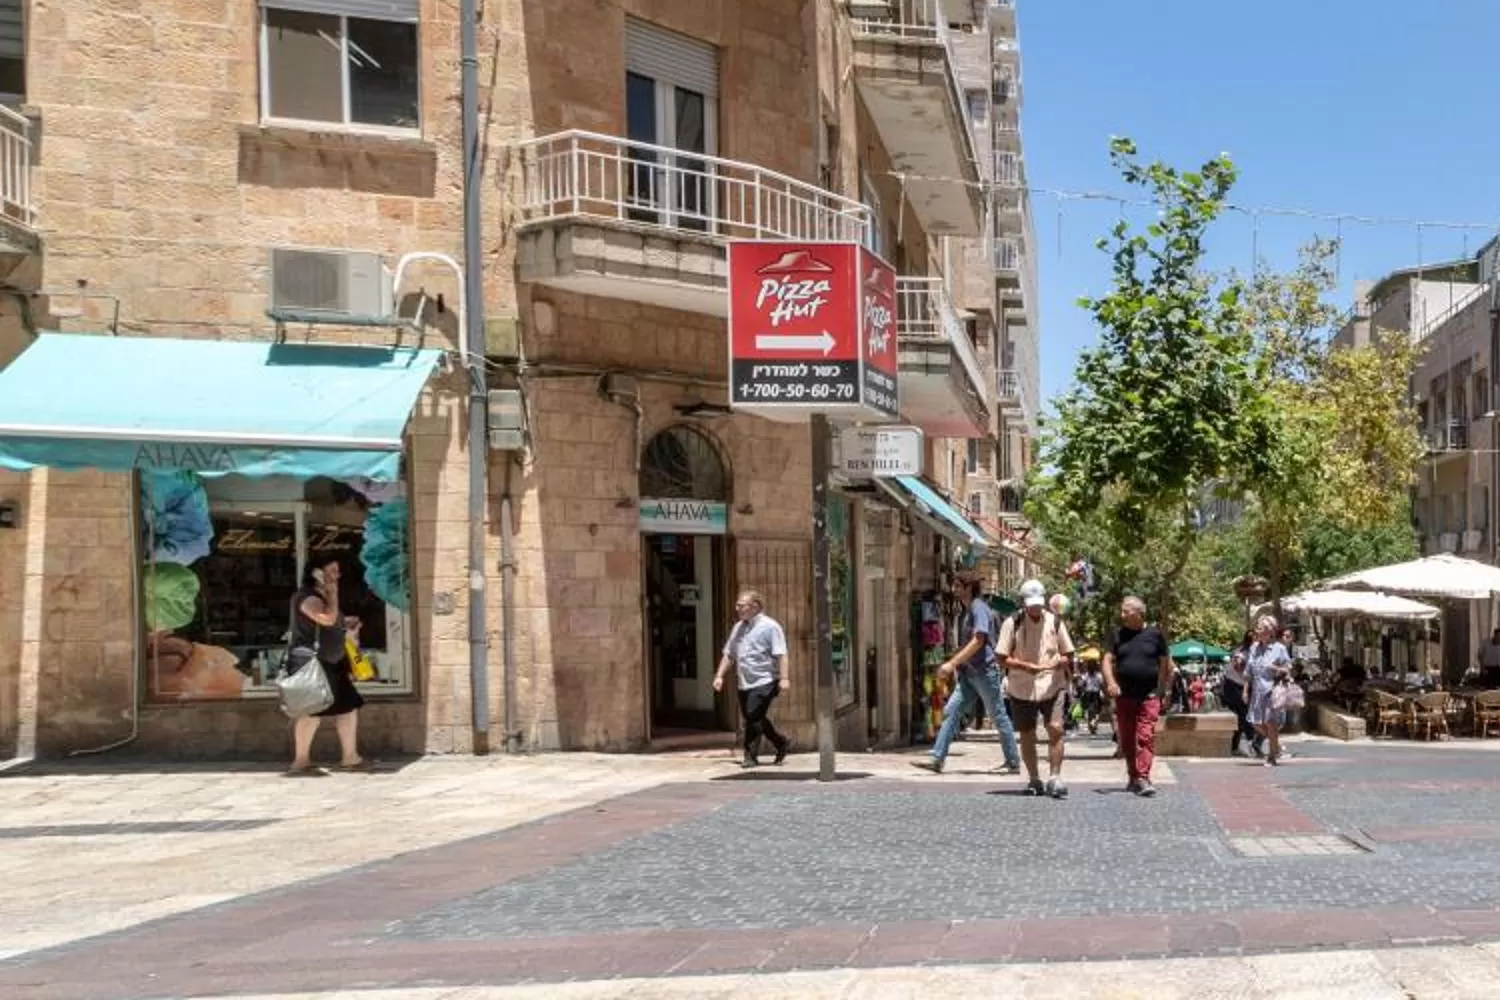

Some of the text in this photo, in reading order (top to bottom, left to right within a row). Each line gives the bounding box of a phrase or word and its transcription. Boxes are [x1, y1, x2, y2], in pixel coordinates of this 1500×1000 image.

[756, 275, 832, 310] Pizza
[769, 296, 828, 328] Hut
[864, 296, 892, 330] Pizza
[752, 363, 841, 379] כשר למהדרין
[740, 383, 854, 398] 1-700-50-60-70
[134, 443, 236, 468] AHAVA
[654, 503, 713, 520] AHAVA
